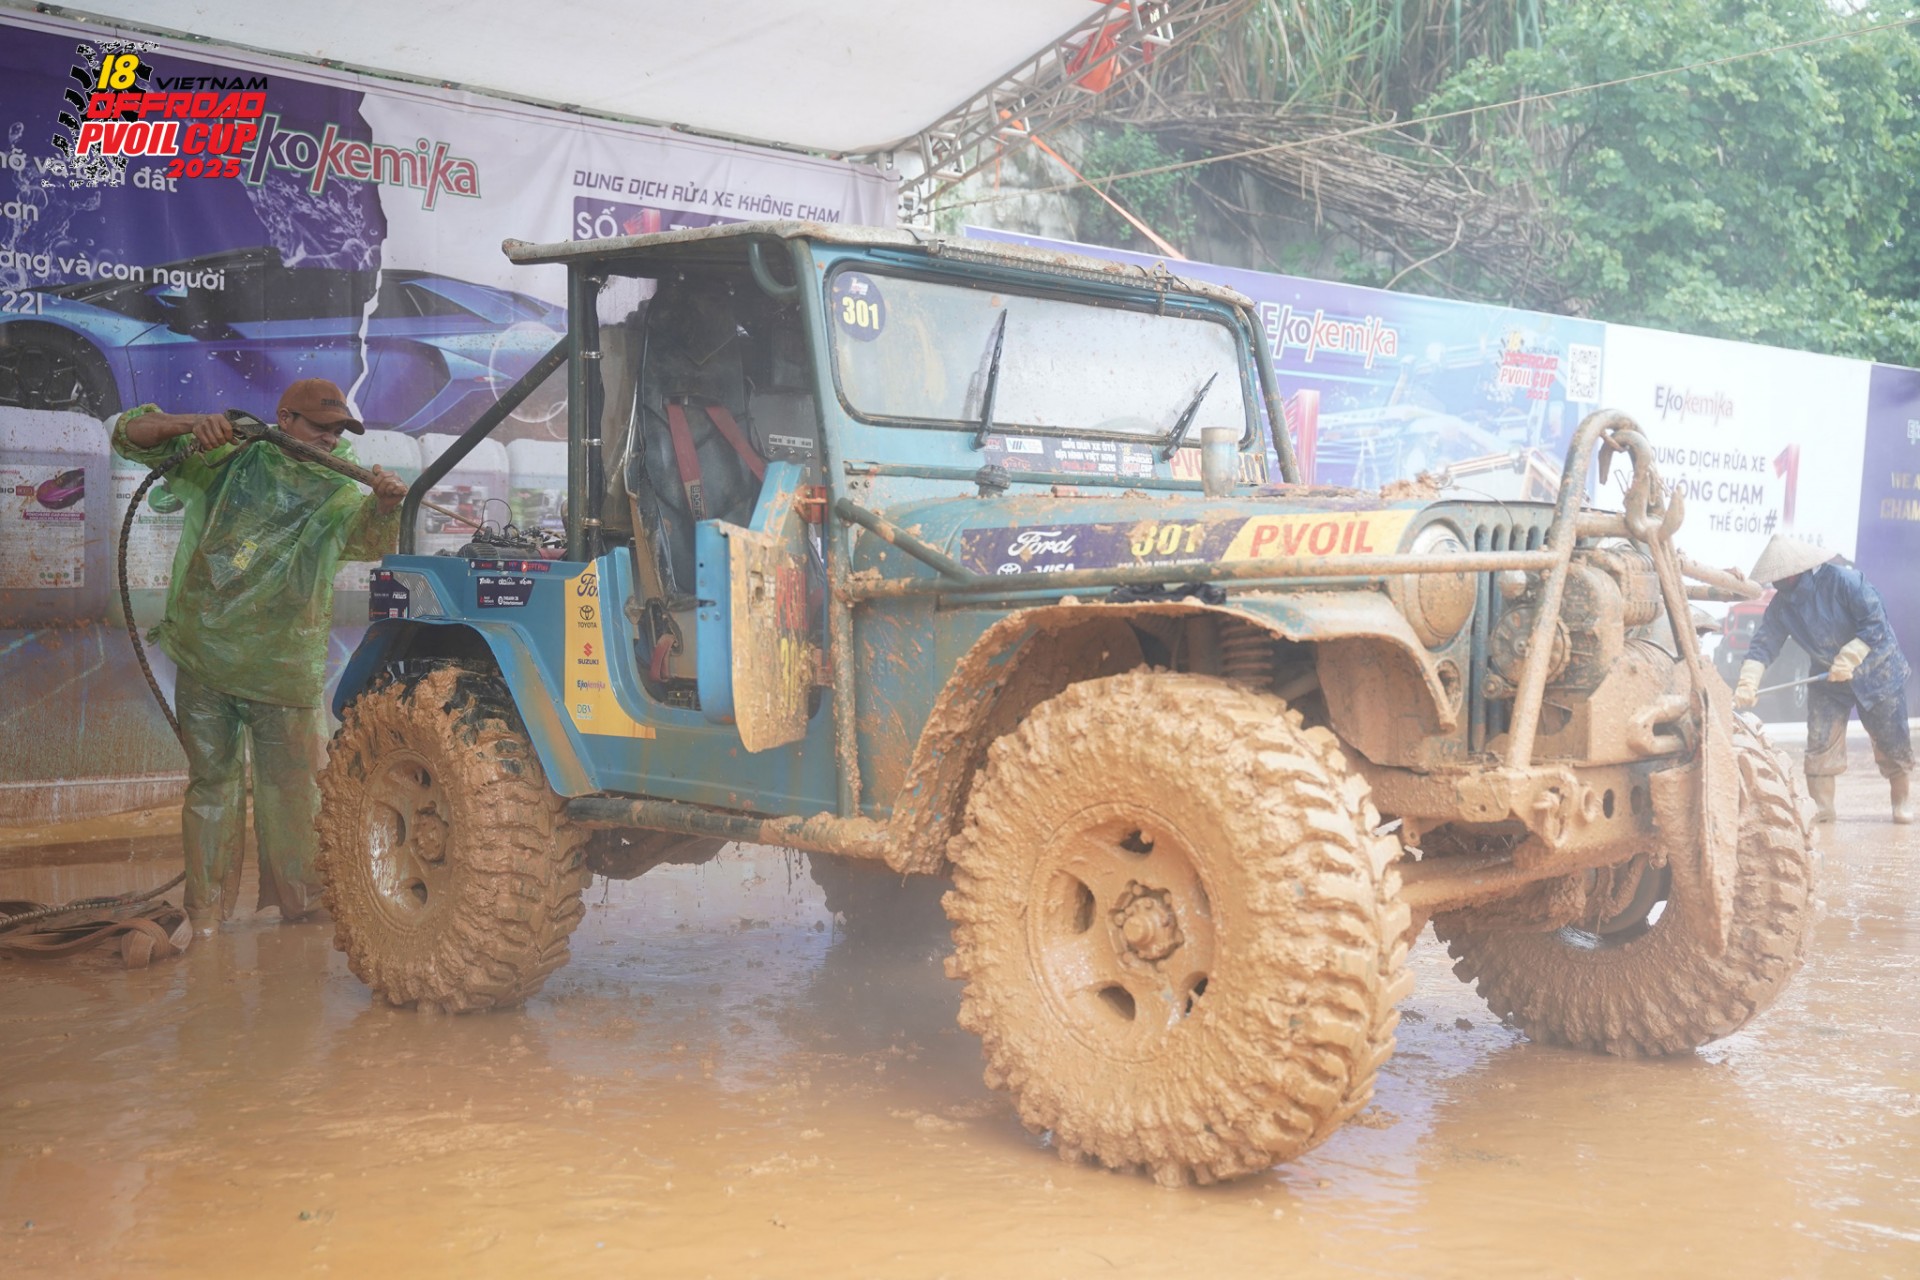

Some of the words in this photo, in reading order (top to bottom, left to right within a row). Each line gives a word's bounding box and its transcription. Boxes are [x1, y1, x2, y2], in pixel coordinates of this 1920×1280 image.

[573, 170, 624, 193] DUNG
[628, 178, 668, 200] DỊCH
[671, 181, 708, 206] RỬA
[712, 191, 734, 208] XE
[739, 194, 793, 218] KHÔNG
[576, 206, 618, 239] SỐ
[58, 253, 91, 277] và
[98, 262, 145, 283] con
[152, 267, 225, 292] người
[842, 296, 879, 330] 301
[1503, 352, 1559, 370] OFFROAD
[1500, 367, 1531, 386] PVOIL
[1532, 371, 1556, 389] CUP
[1689, 449, 1720, 472] DỊCH
[1751, 456, 1766, 472] XE
[1718, 483, 1764, 510] CHẠM
[1008, 530, 1077, 557] Ford
[1131, 523, 1201, 556] 301
[1250, 521, 1373, 559] PVOIL
